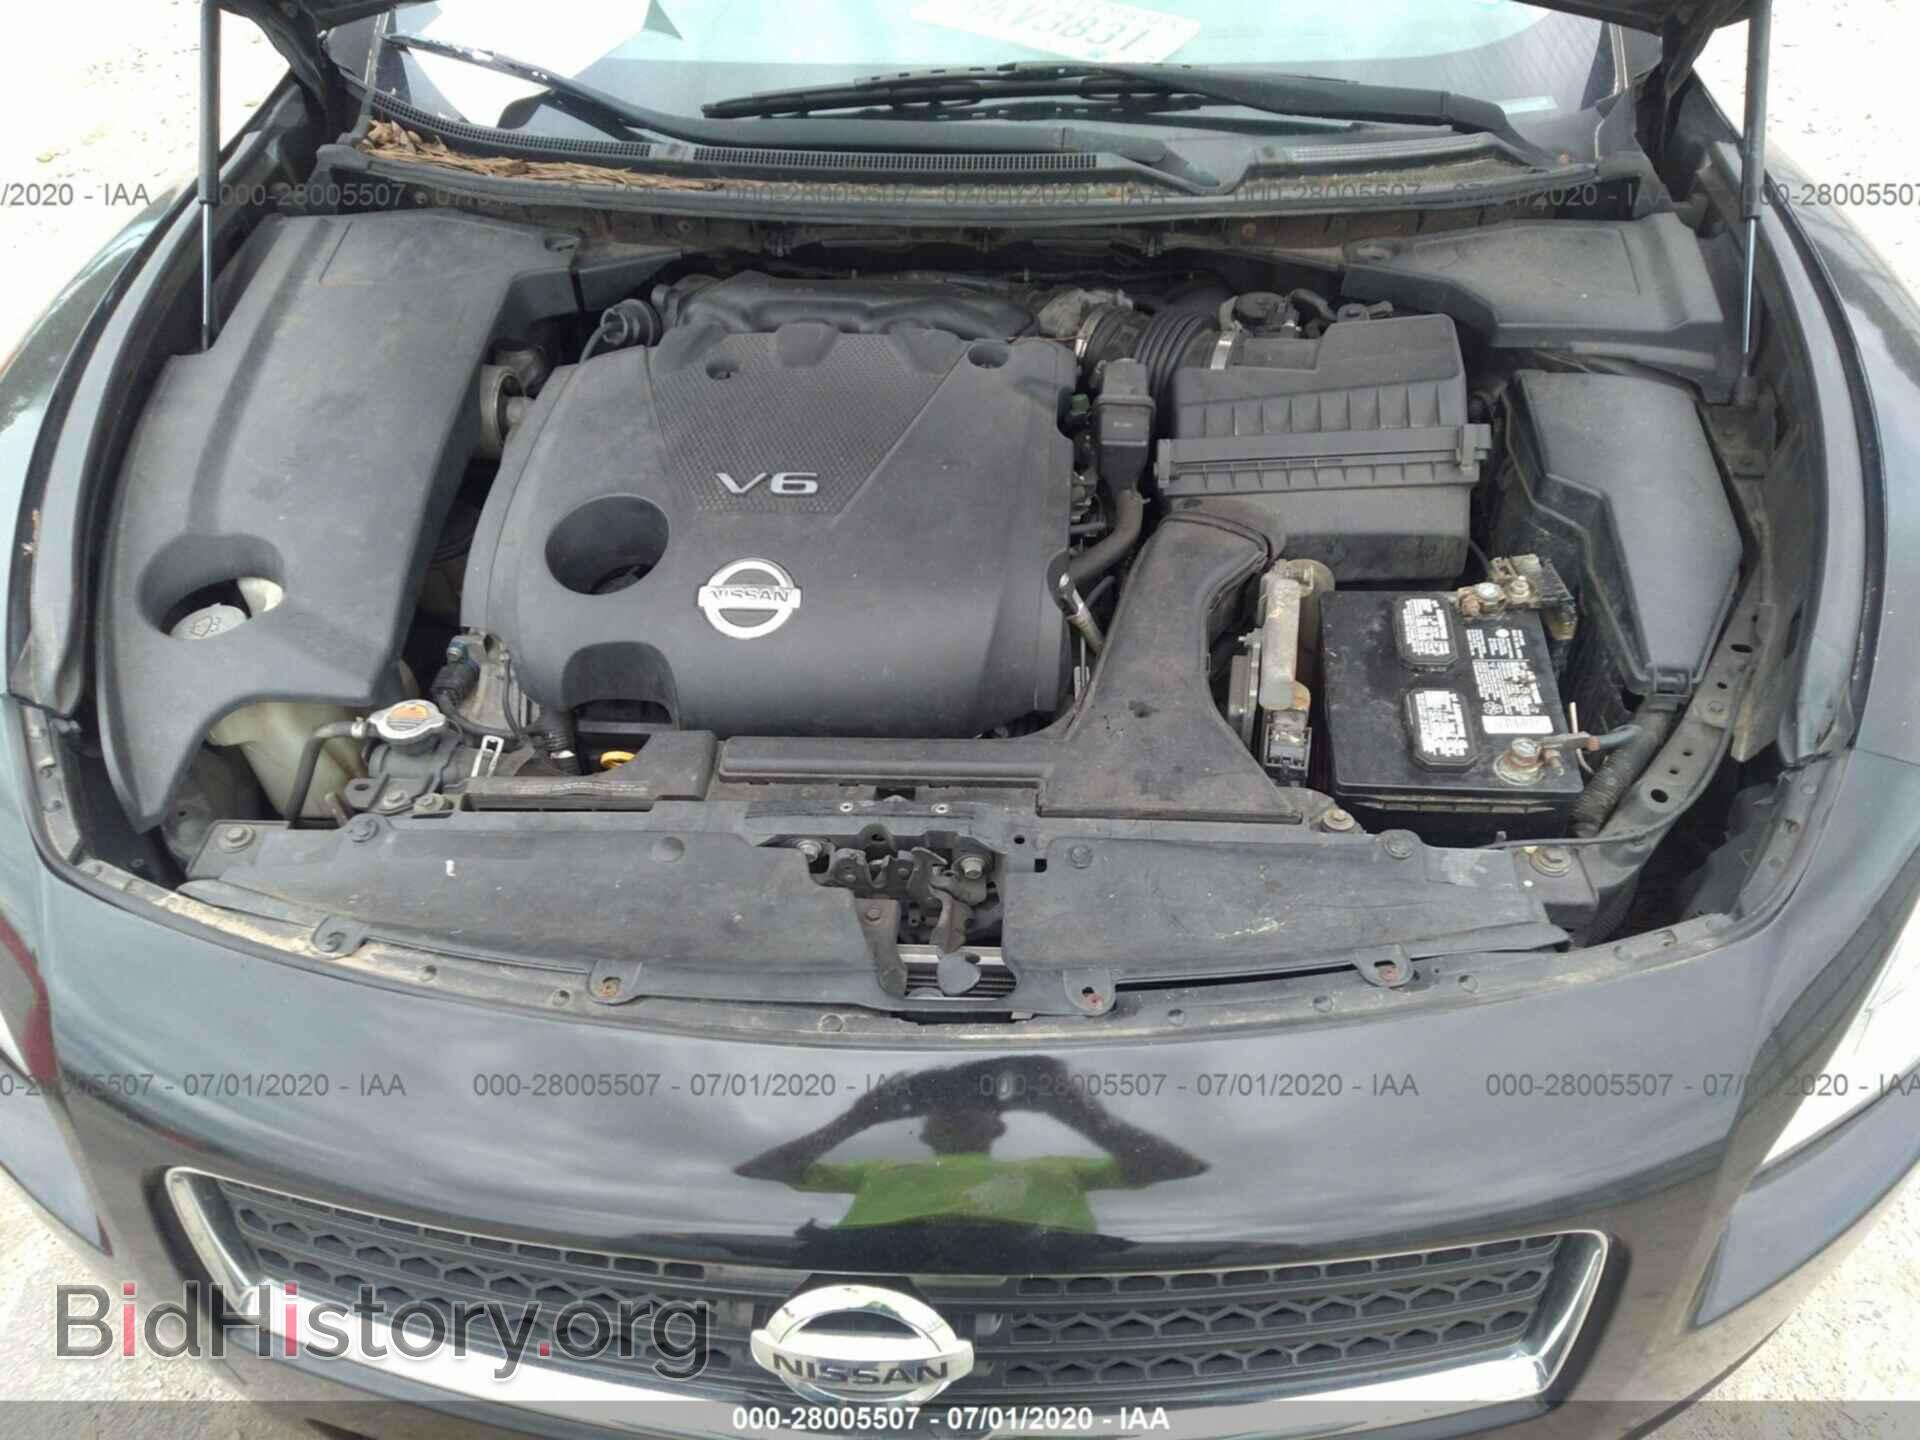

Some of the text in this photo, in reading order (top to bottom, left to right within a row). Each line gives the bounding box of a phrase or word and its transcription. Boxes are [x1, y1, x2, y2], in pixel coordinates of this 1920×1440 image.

[716, 472, 819, 494] V6
[710, 588, 789, 603] NISSAN
[772, 1353, 949, 1385] NISSAN
